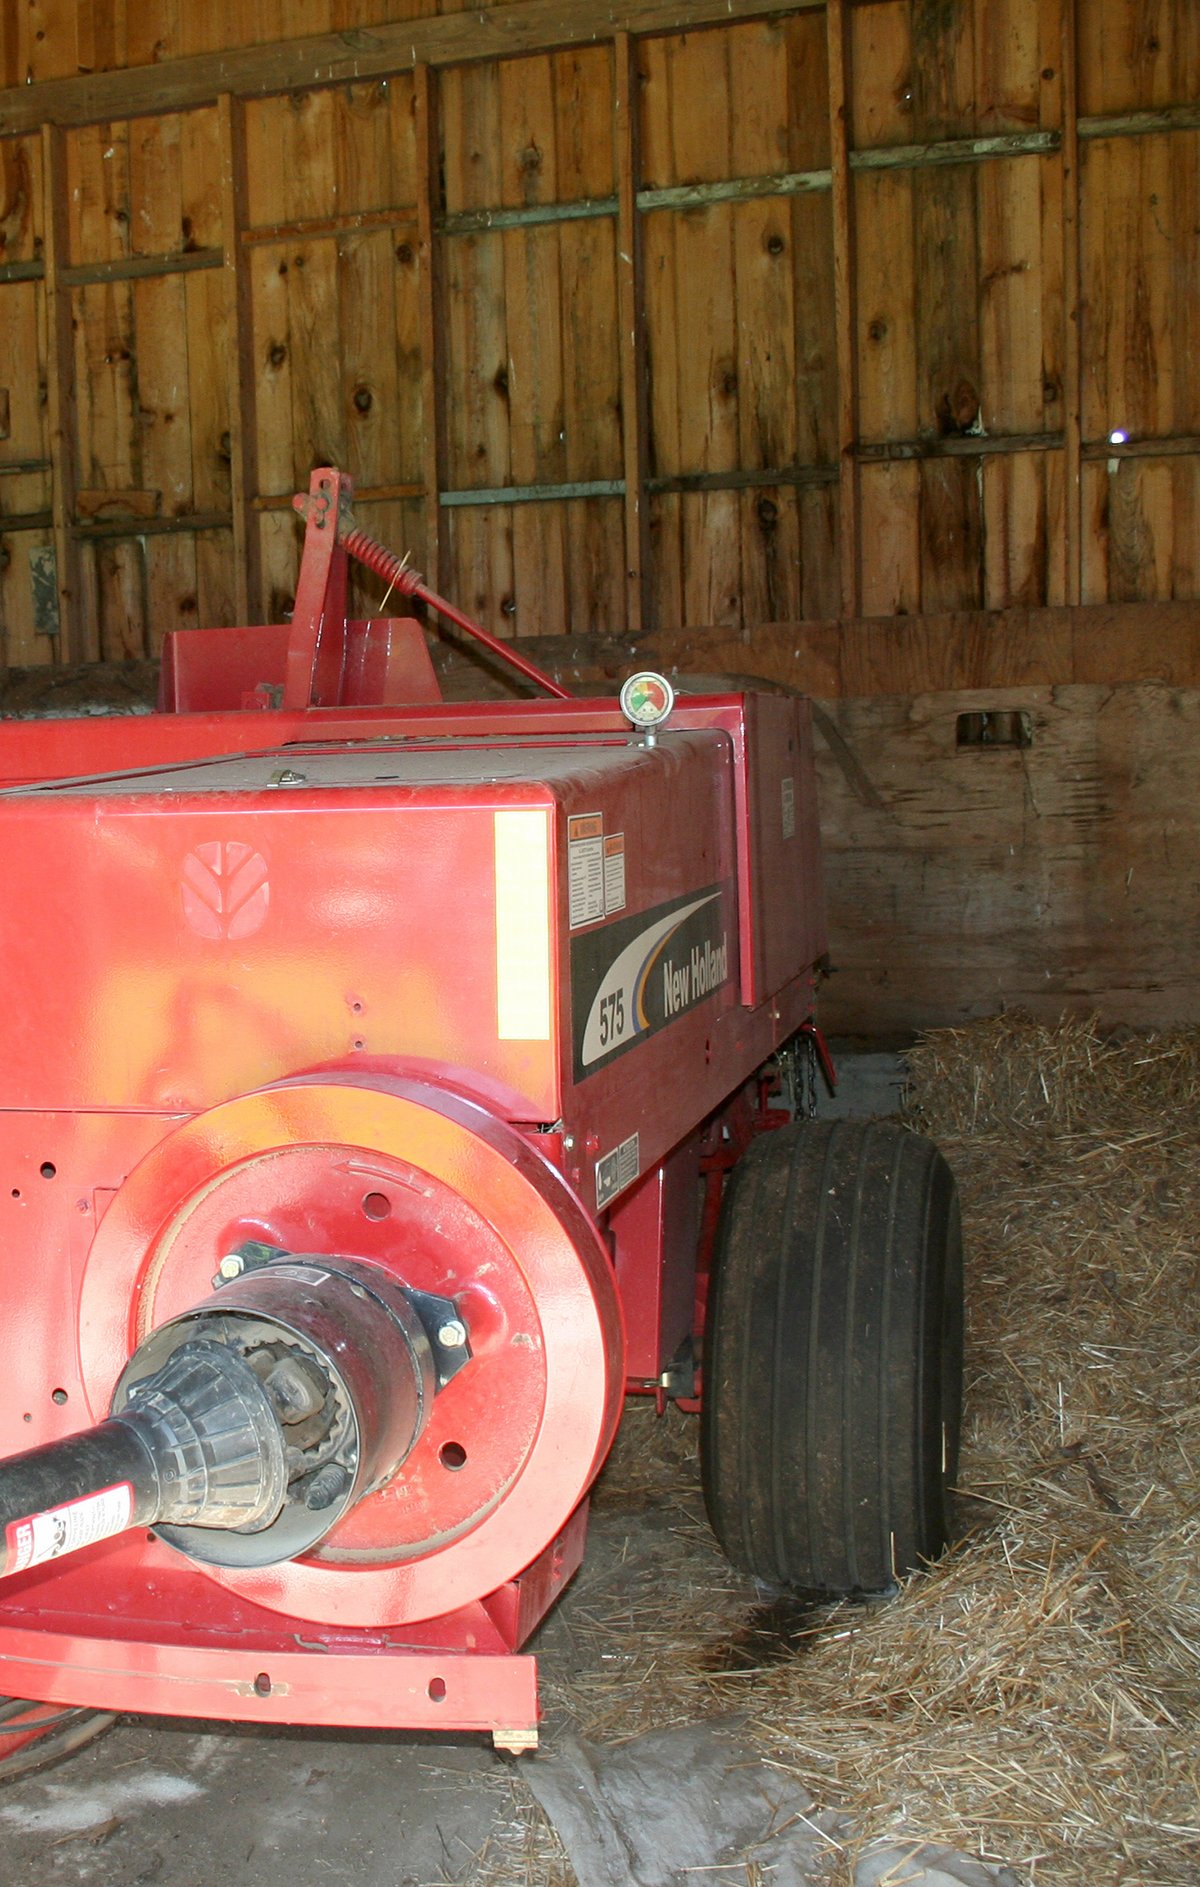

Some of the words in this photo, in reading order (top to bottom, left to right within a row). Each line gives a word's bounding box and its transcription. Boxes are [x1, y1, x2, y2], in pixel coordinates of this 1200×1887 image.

[663, 960, 690, 1018] New
[691, 931, 728, 1001] Holland
[599, 987, 625, 1047] 575
